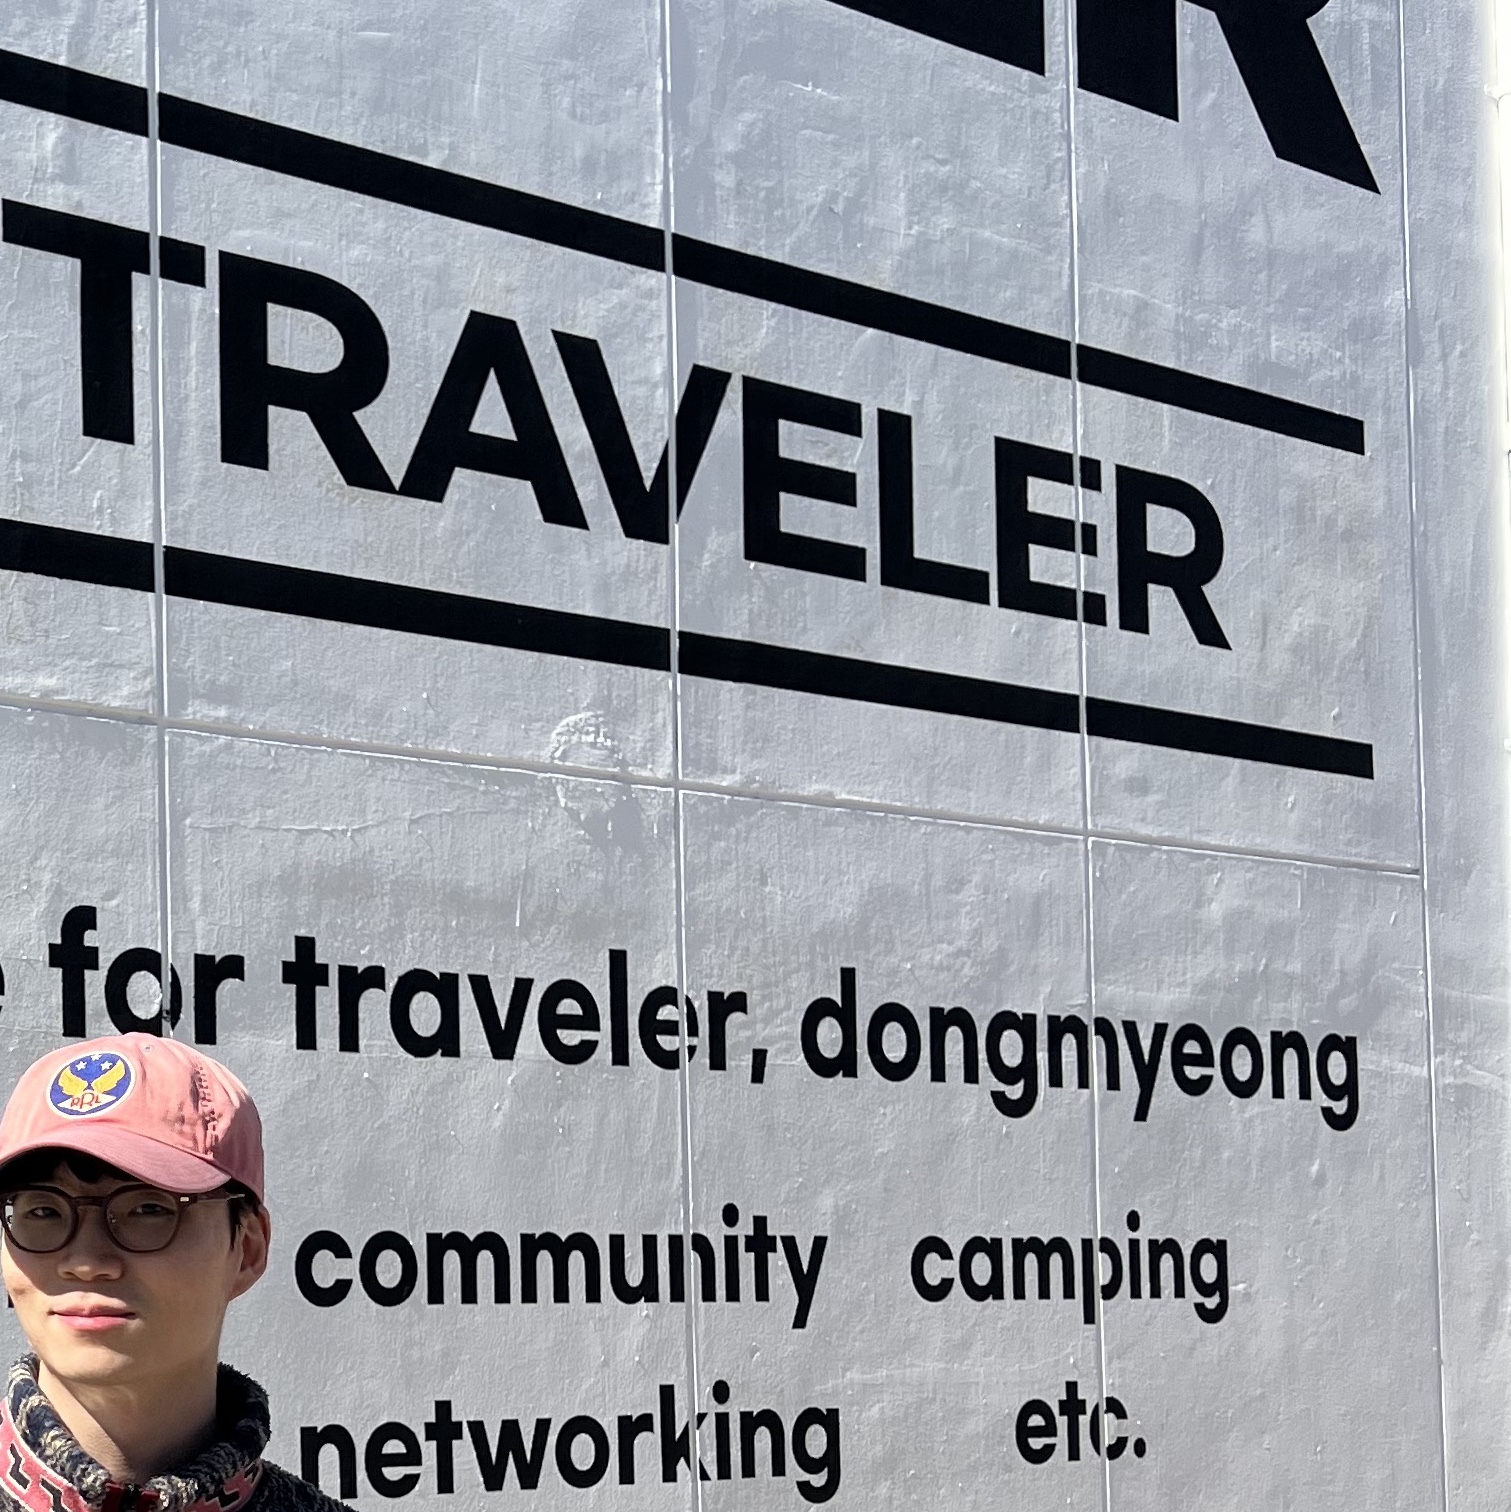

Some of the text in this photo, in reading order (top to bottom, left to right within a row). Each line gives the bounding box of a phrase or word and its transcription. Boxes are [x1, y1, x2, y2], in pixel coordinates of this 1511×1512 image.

[2, 198, 1232, 650] TRAVELER
[48, 905, 245, 1046] for
[281, 936, 768, 1084] traveler,
[800, 967, 1359, 1132] dongmyeong
[294, 1203, 828, 1330] community
[910, 1210, 1229, 1325] camping
[300, 1380, 841, 1504] networking
[1015, 1381, 1147, 1465] etc.
